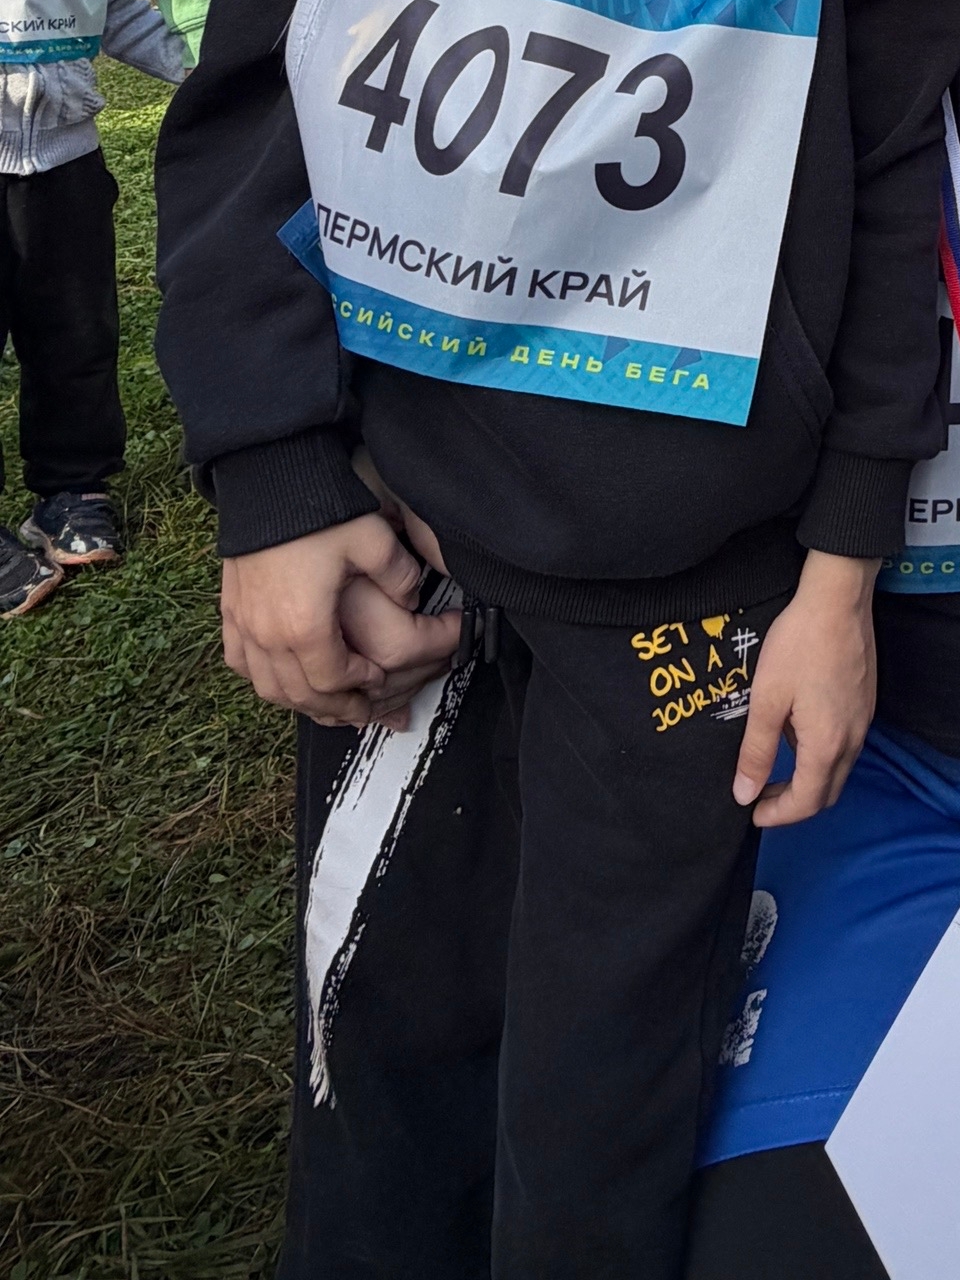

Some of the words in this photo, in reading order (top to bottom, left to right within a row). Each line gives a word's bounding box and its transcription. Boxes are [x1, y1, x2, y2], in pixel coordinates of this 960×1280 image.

[317, 202, 517, 297] ПЕРМСКИЙ
[527, 267, 652, 312] КРАЙ
[510, 344, 604, 374] ДЕНЬ
[625, 362, 711, 392] БЕГА
[630, 622, 690, 661] SET
[650, 657, 696, 698] ON
[707, 644, 723, 673] A
[652, 663, 748, 732] JOURNEY
